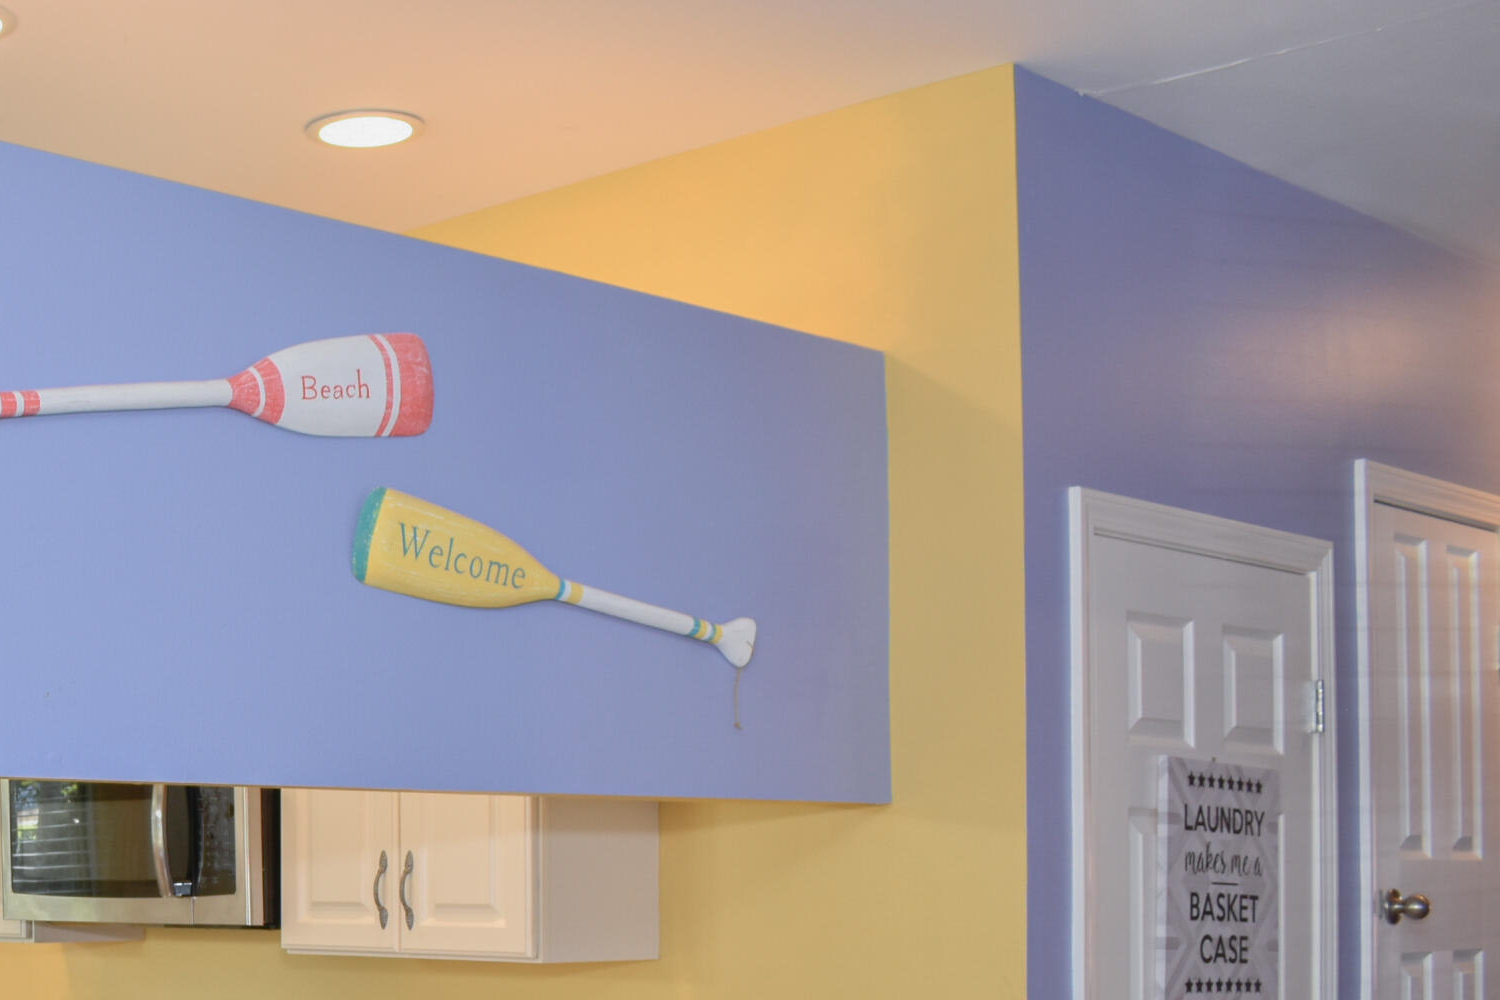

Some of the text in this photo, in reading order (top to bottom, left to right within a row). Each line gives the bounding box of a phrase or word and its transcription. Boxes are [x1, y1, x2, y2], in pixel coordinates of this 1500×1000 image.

[300, 367, 371, 401] Beach
[398, 520, 527, 590] Welcome
[1183, 803, 1266, 837] LAUNDRY
[1184, 841, 1263, 878] makes me a
[1189, 891, 1260, 924] BASKET
[1200, 934, 1250, 965] CASE
